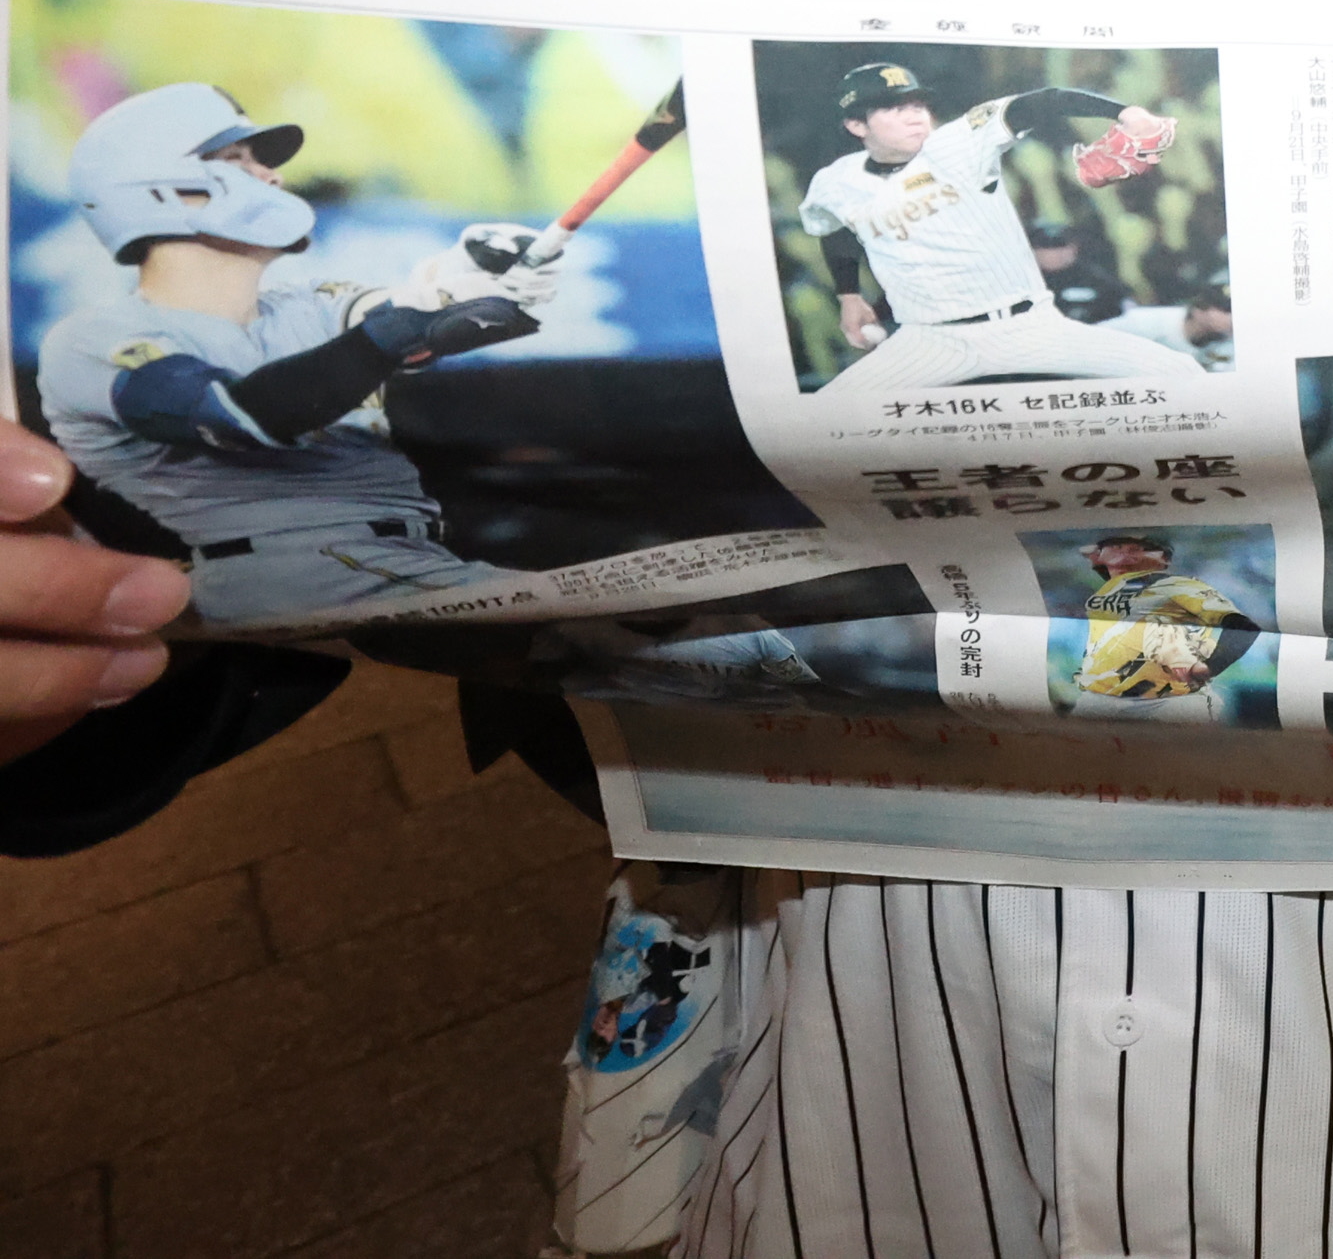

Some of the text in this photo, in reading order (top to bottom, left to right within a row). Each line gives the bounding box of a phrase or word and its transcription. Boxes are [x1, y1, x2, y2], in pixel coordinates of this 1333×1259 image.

[882, 389, 1168, 418] 才木16K セ記録並ぶ
[861, 454, 1242, 493] 王者の座
[881, 485, 1248, 520] 譲らない
